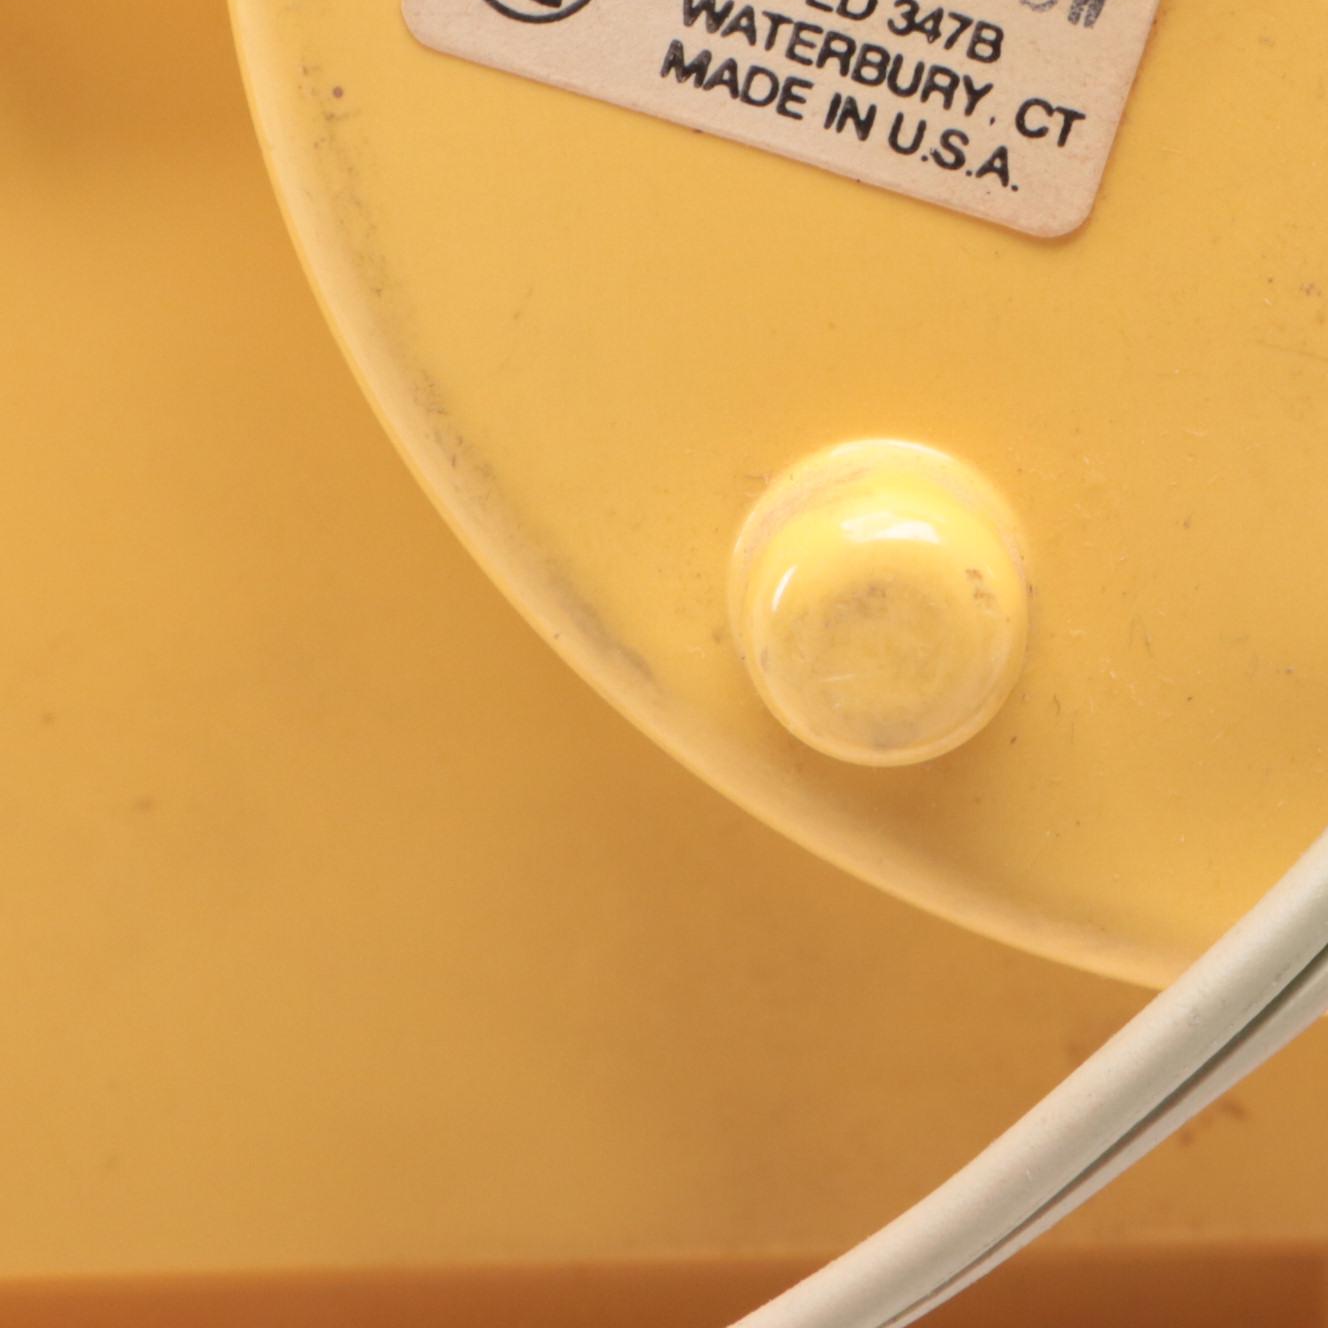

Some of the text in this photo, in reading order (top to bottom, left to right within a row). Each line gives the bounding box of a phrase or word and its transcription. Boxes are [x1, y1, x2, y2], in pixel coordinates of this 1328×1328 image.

[660, 39, 1020, 192] MADE IN U.S.A.
[1014, 98, 1086, 148] CT
